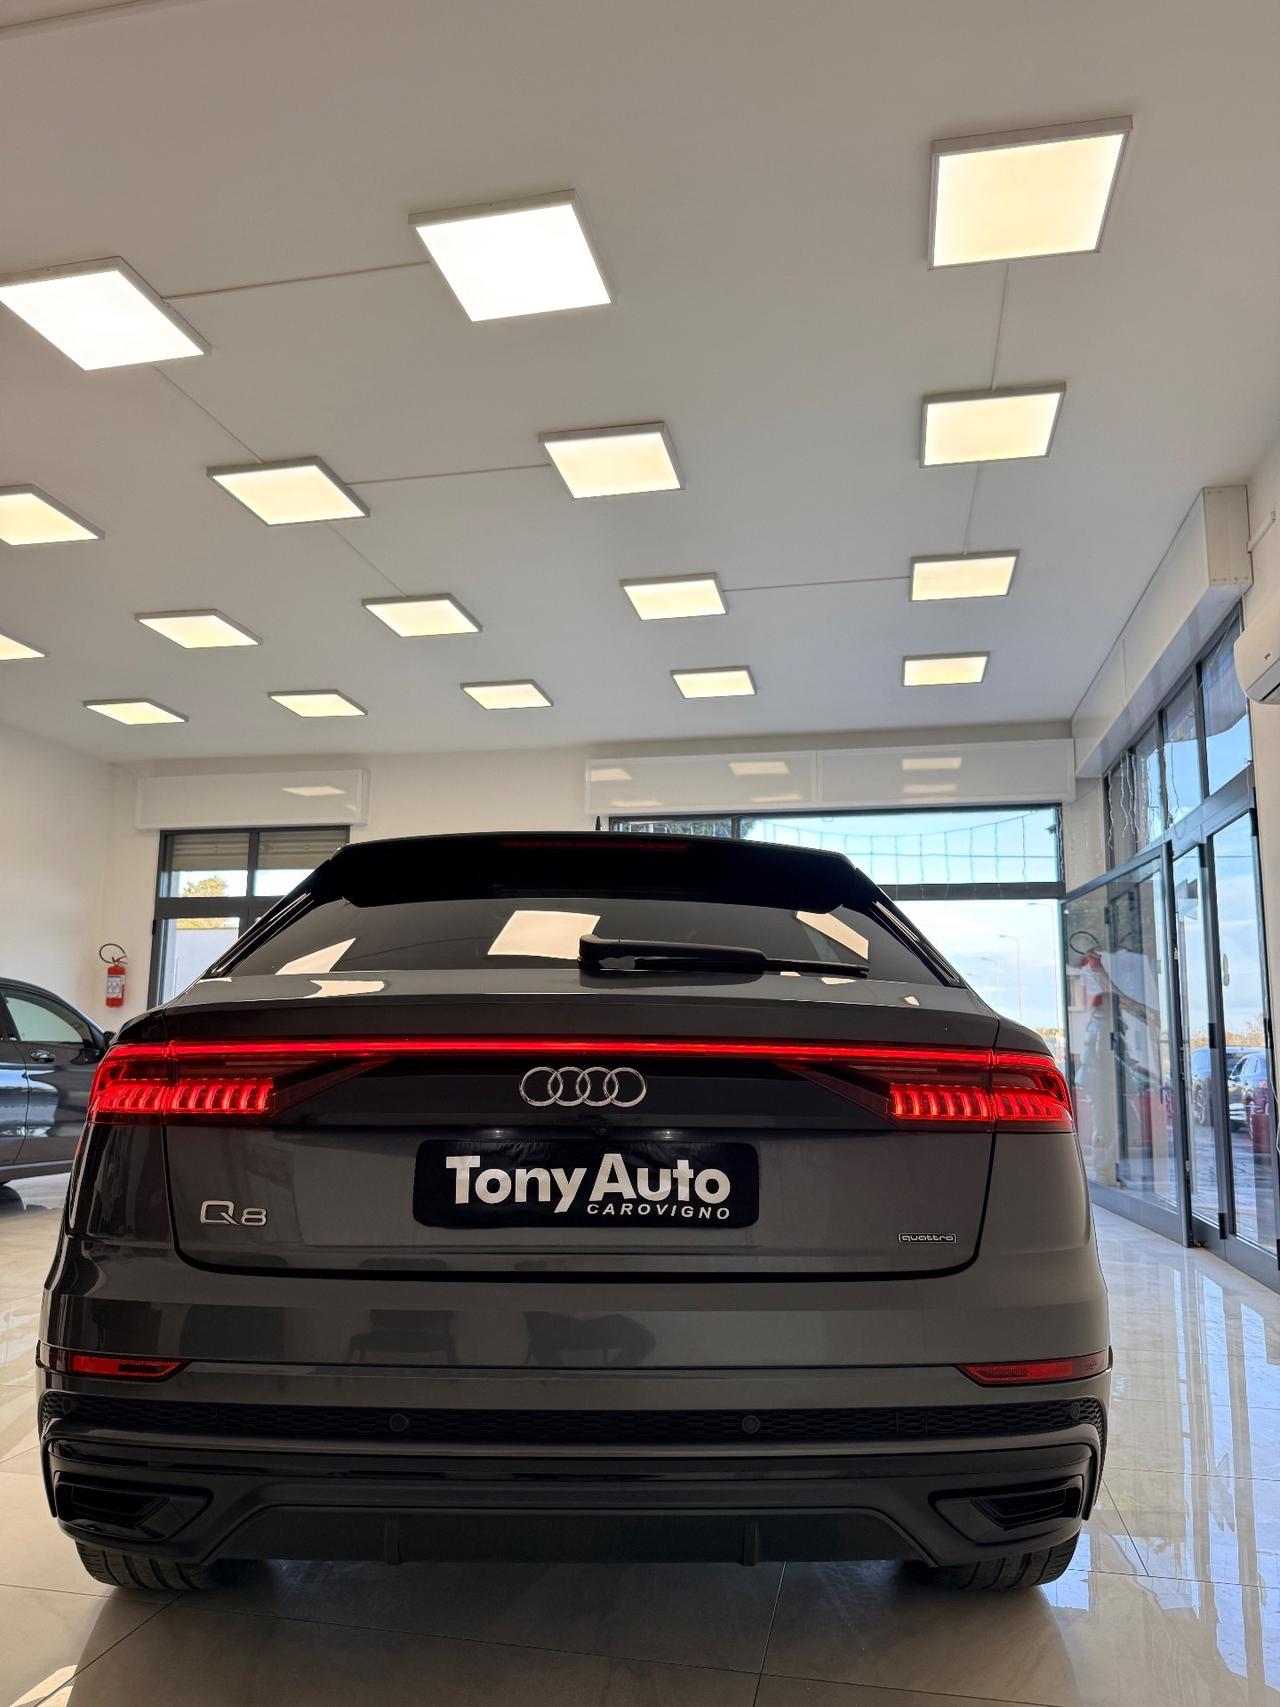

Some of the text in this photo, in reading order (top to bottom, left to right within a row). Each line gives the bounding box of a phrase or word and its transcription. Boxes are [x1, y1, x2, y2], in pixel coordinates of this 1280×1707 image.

[446, 1153, 731, 1213] Tony Auto
[200, 1200, 267, 1226] Q8
[587, 1203, 730, 1220] CAROVIGNO
[901, 1234, 954, 1242] quattro
